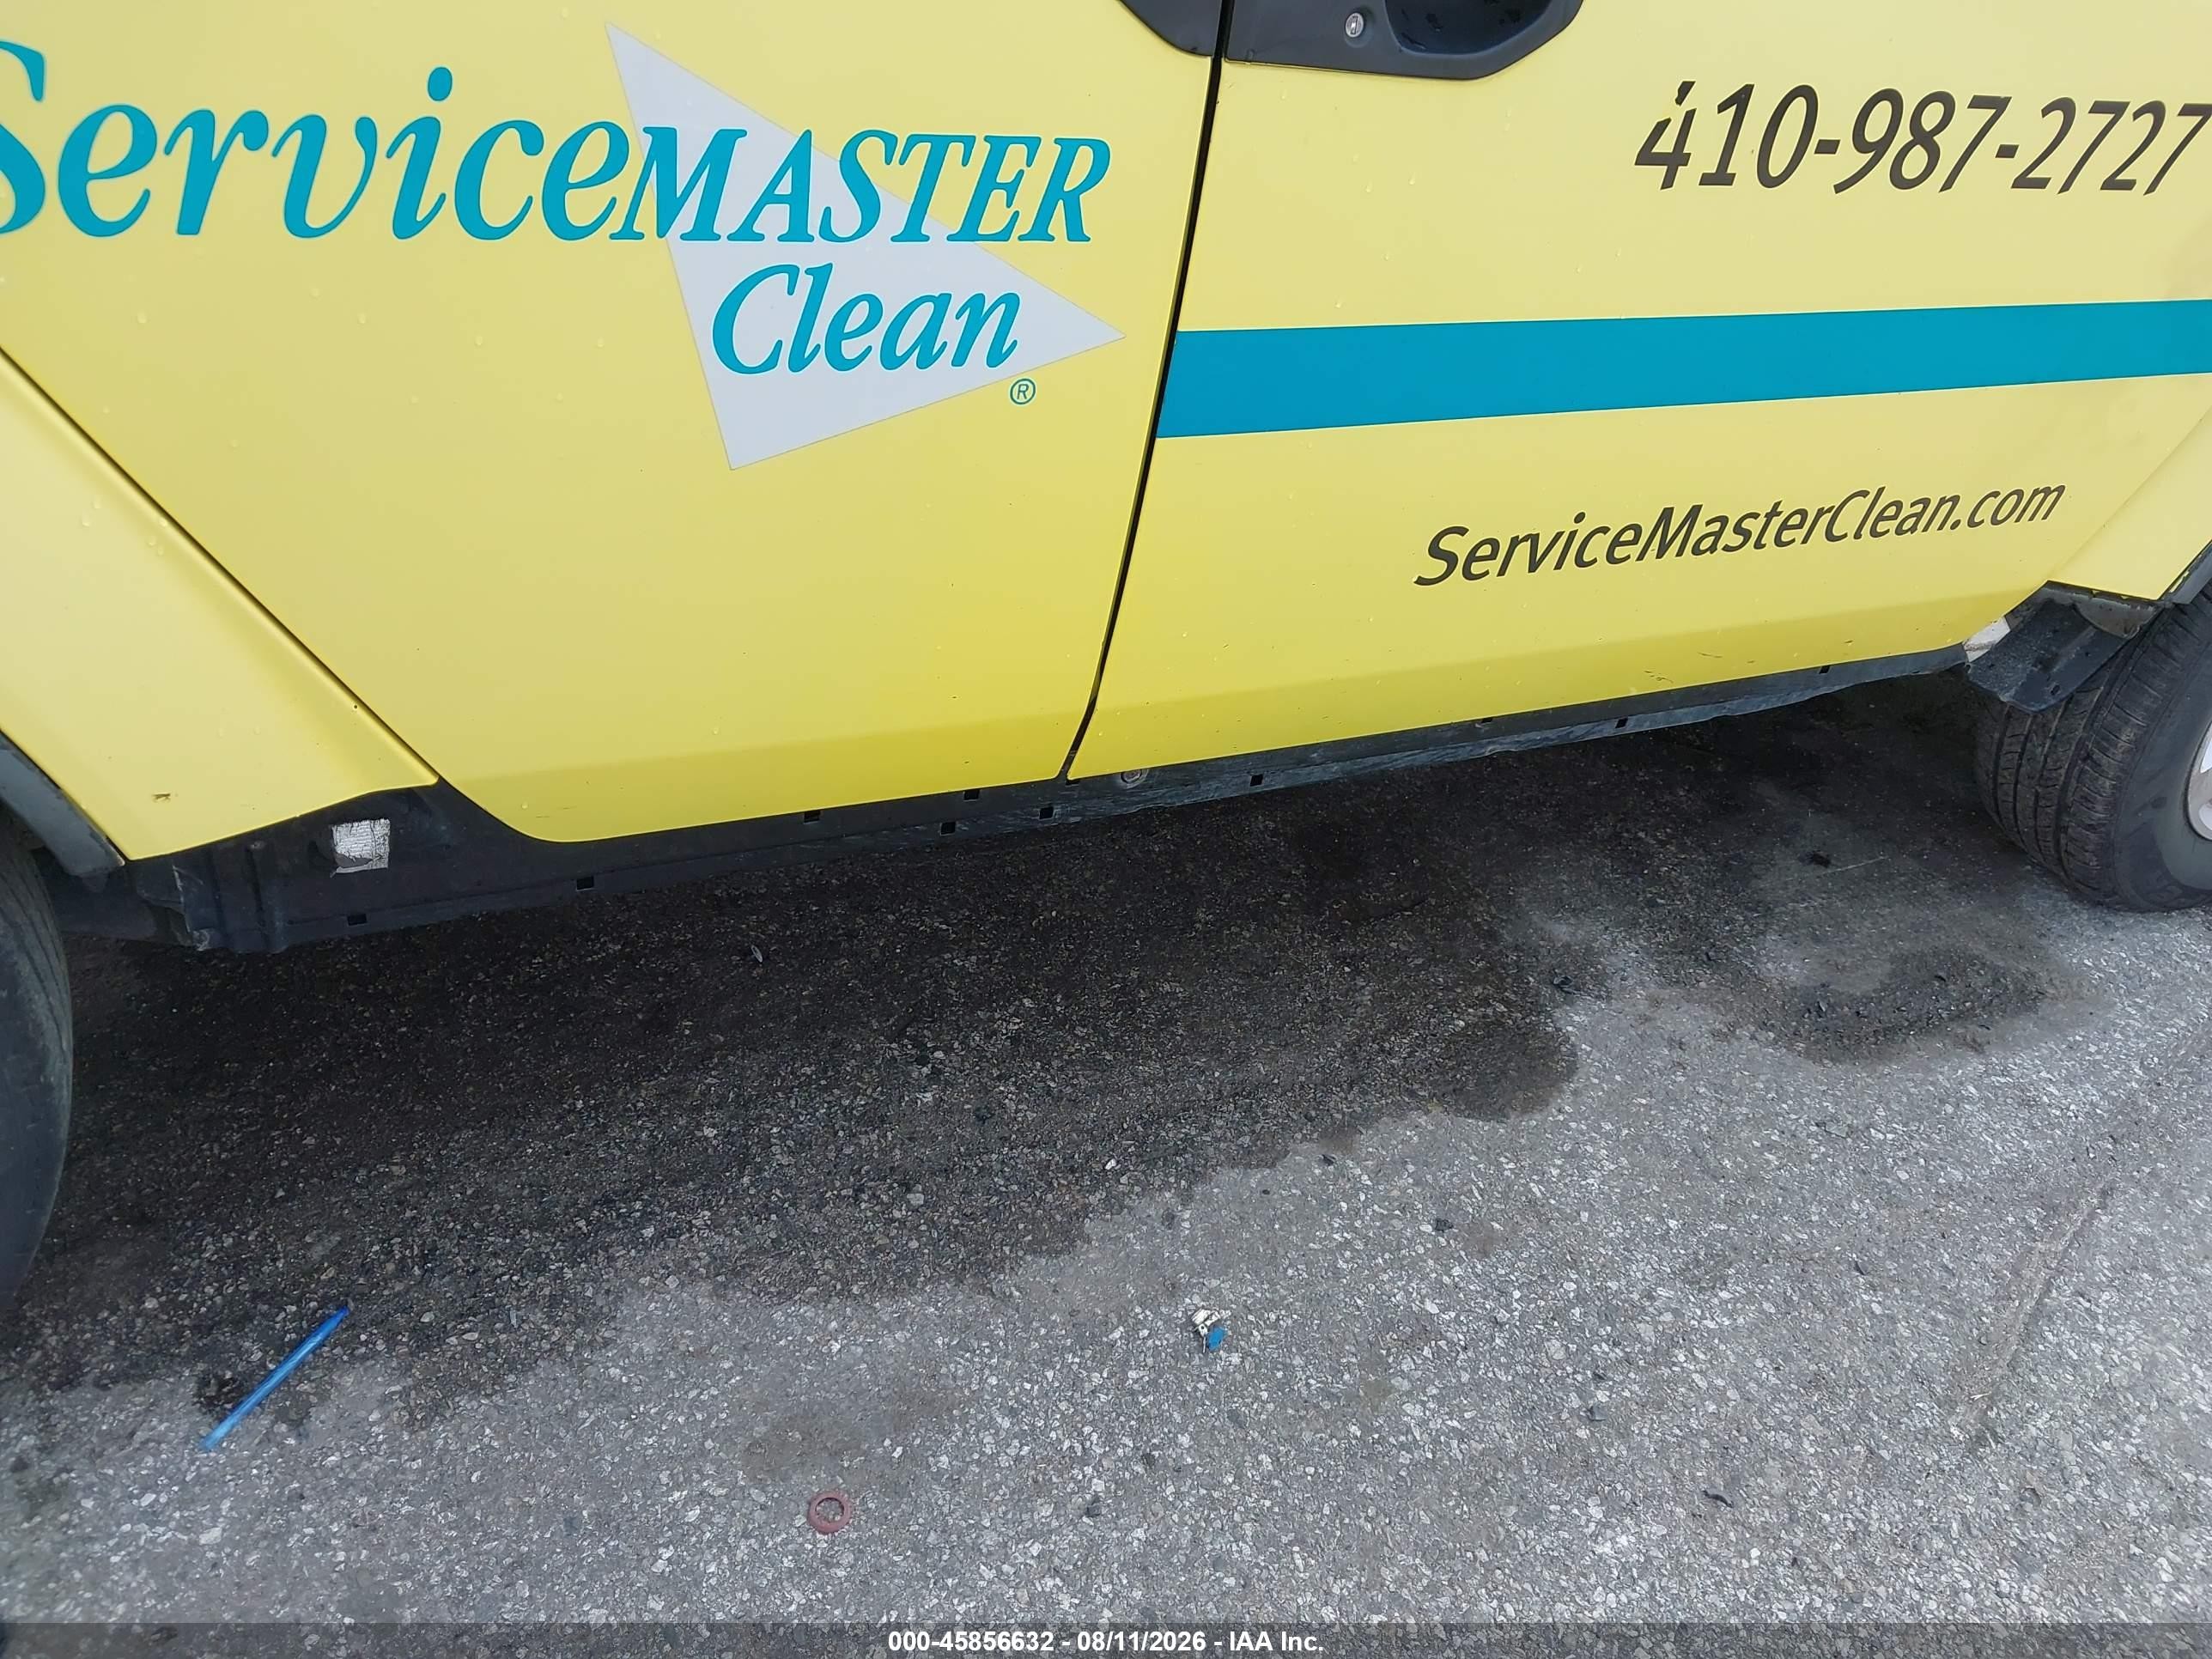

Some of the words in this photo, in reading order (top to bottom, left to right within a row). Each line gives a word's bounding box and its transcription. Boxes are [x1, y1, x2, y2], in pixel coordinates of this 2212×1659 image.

[1633, 81, 2212, 196] 410-987-2727
[711, 262, 1022, 375] Clean
[1413, 483, 2067, 587] ServiceMasterClean.com
